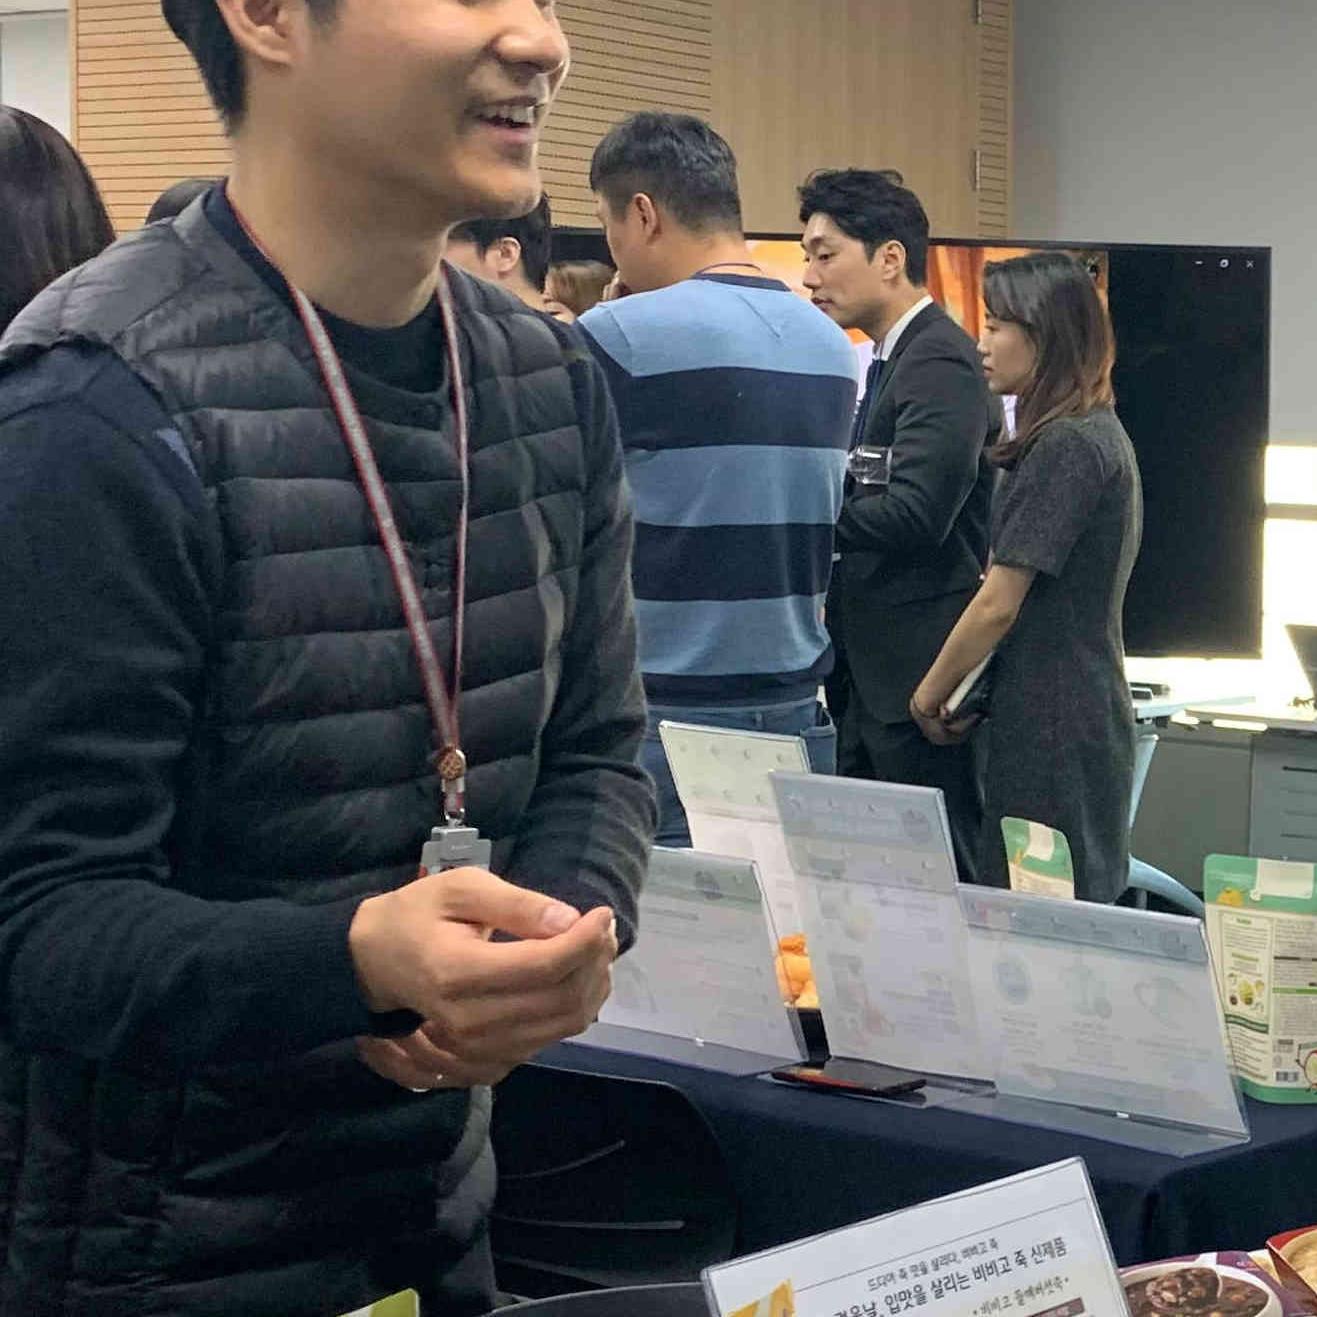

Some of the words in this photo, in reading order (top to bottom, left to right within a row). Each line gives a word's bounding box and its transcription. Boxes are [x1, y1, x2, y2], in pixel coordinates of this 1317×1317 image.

[884, 1284, 928, 1315] 입맛을
[930, 1272, 971, 1300] 살리는
[971, 1255, 1013, 1283] 비비고
[1014, 1249, 1028, 1269] 죽
[1031, 1236, 1068, 1262] 신제품
[980, 1296, 1013, 1315] 비비고
